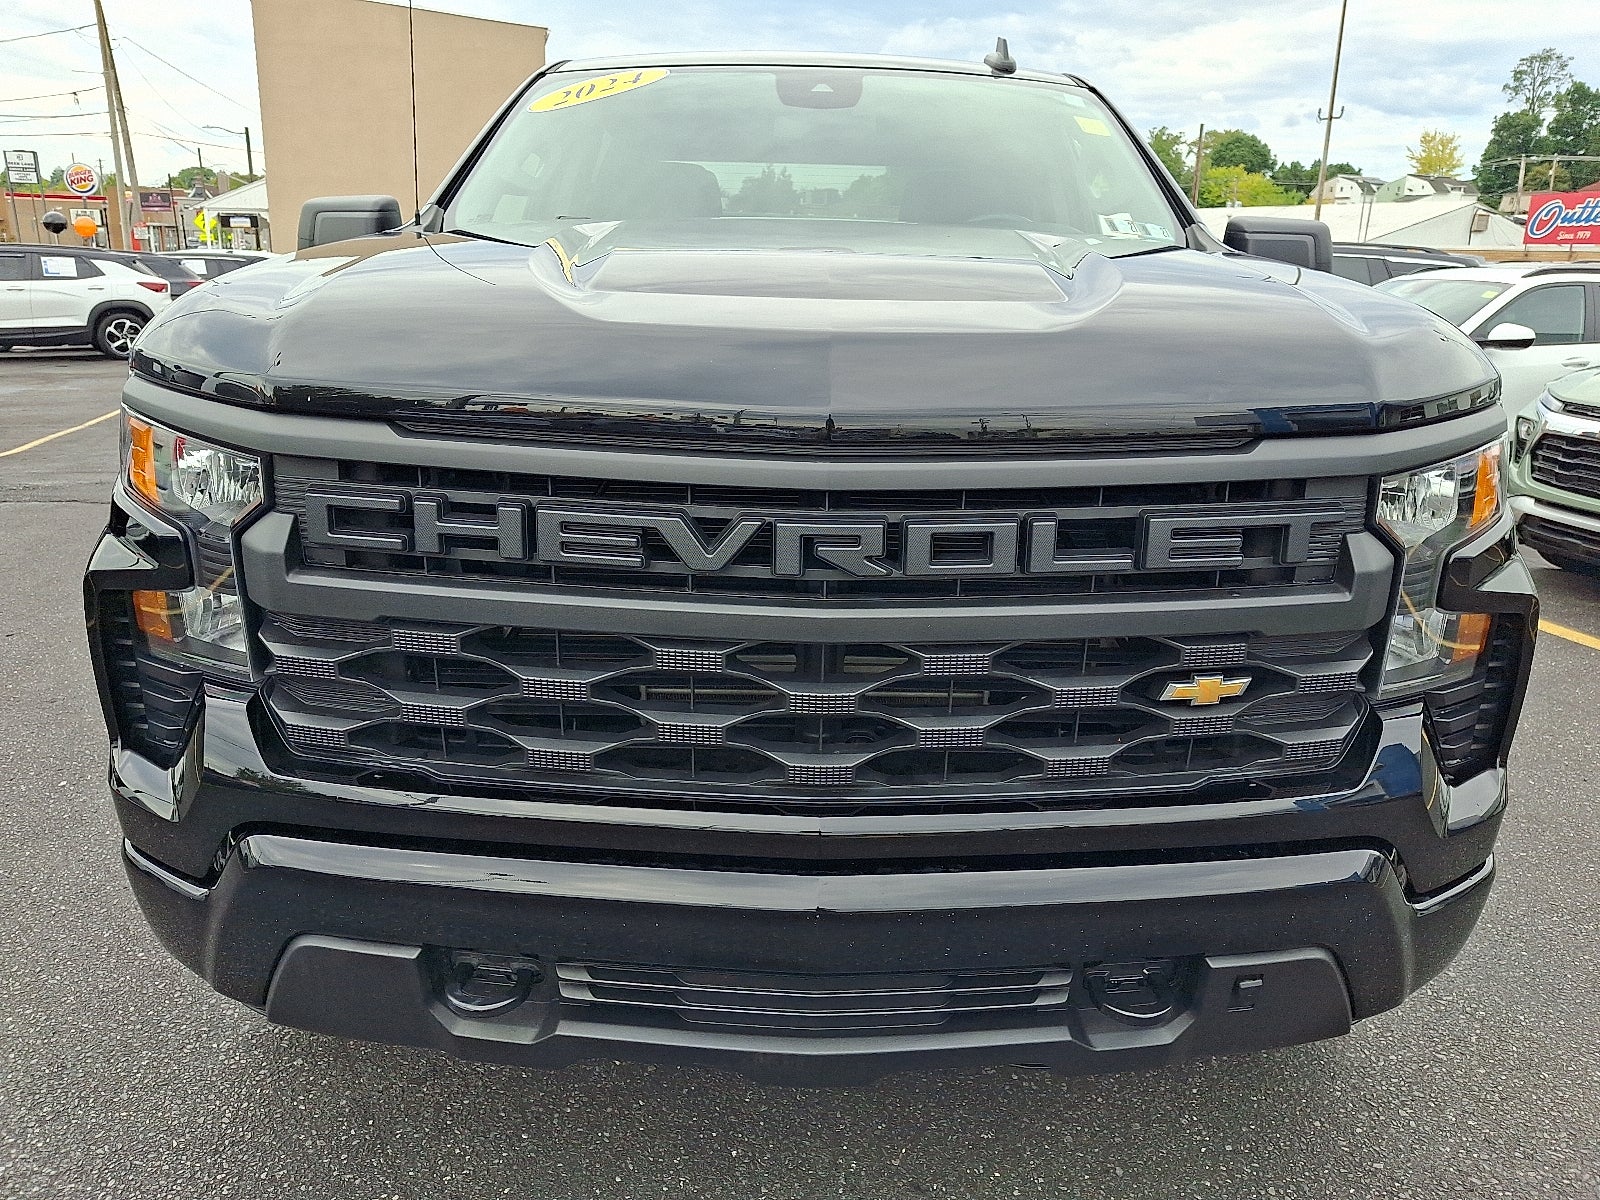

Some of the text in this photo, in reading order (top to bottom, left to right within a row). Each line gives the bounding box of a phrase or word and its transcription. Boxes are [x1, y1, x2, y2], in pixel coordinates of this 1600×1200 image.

[553, 71, 643, 107] 2024
[68, 169, 93, 179] BURGER
[70, 174, 94, 187] KING
[1557, 230, 1592, 241] Since 1979
[304, 482, 1347, 578] CHEVROLET
